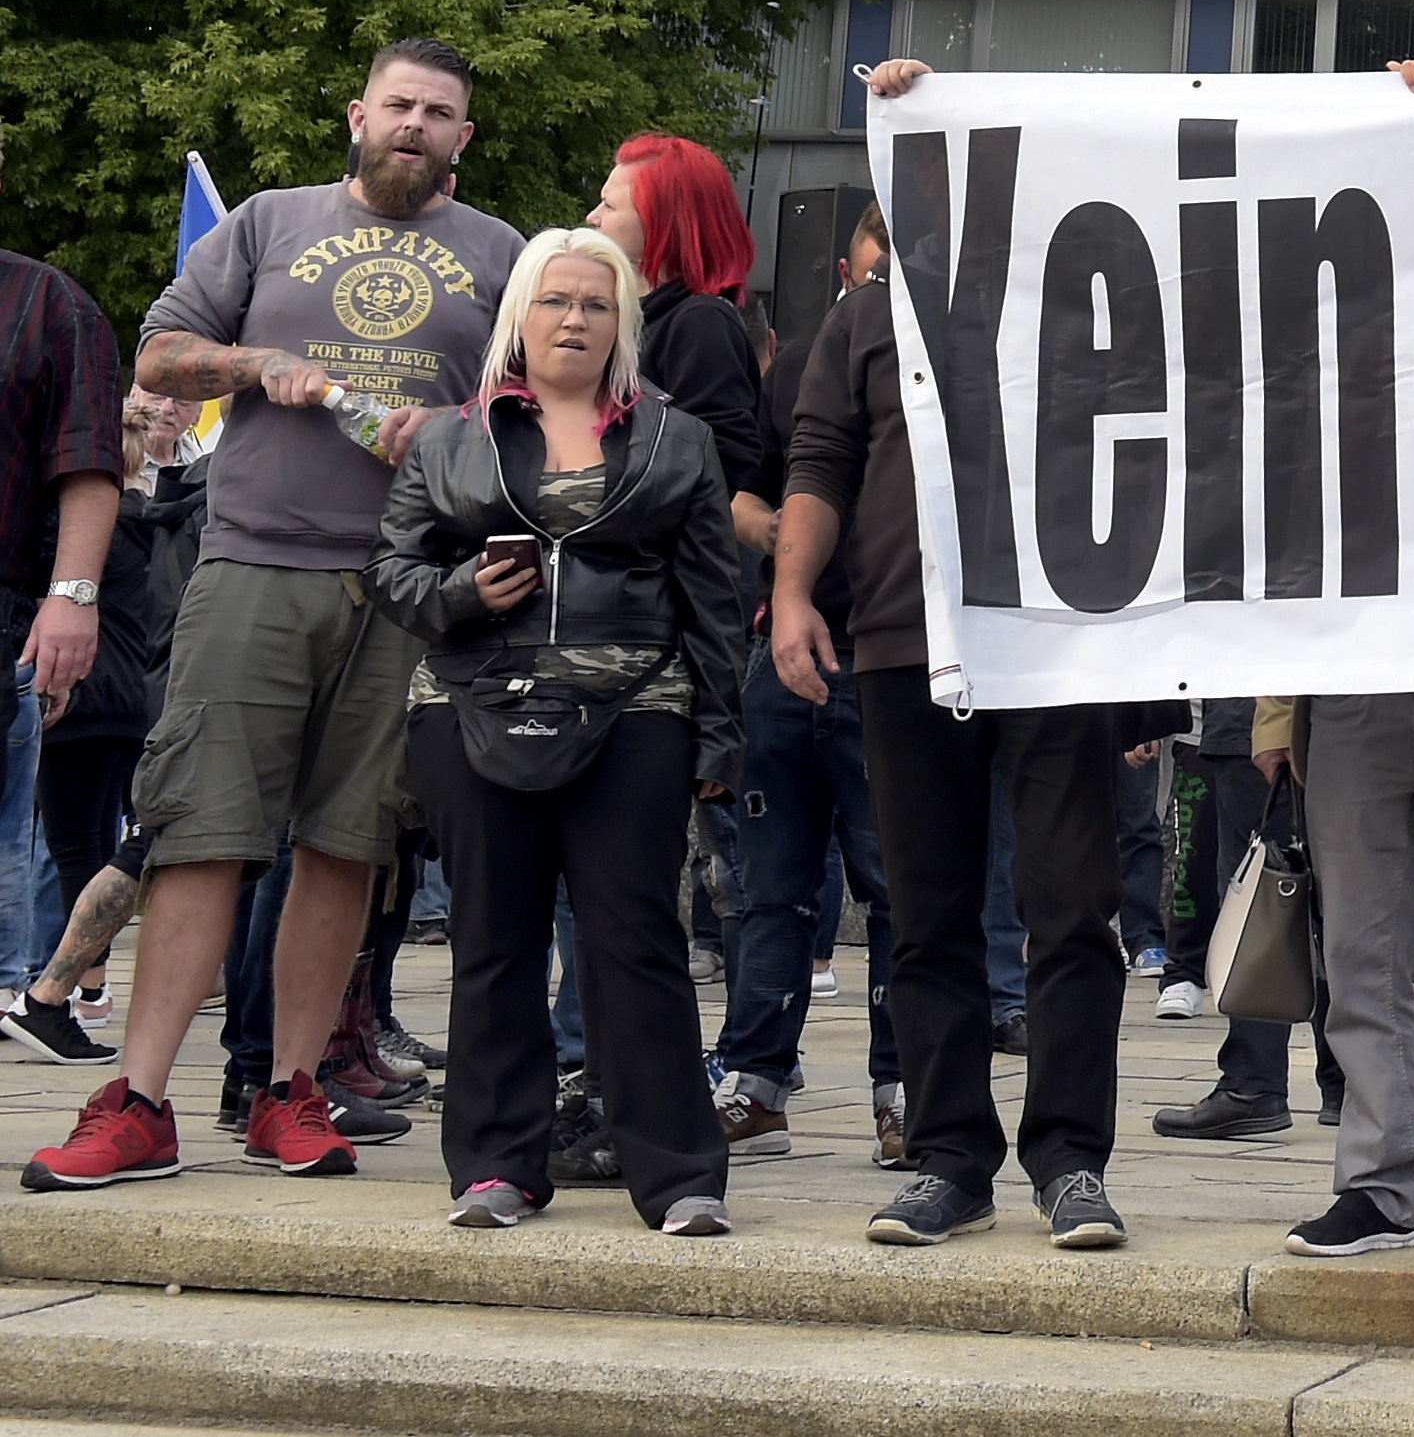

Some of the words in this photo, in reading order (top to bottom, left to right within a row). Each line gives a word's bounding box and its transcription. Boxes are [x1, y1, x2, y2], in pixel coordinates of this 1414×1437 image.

[289, 226, 476, 300] SYMPATHY
[306, 343, 344, 360] FOR
[348, 346, 385, 363] THE
[389, 350, 440, 371] DEVIL
